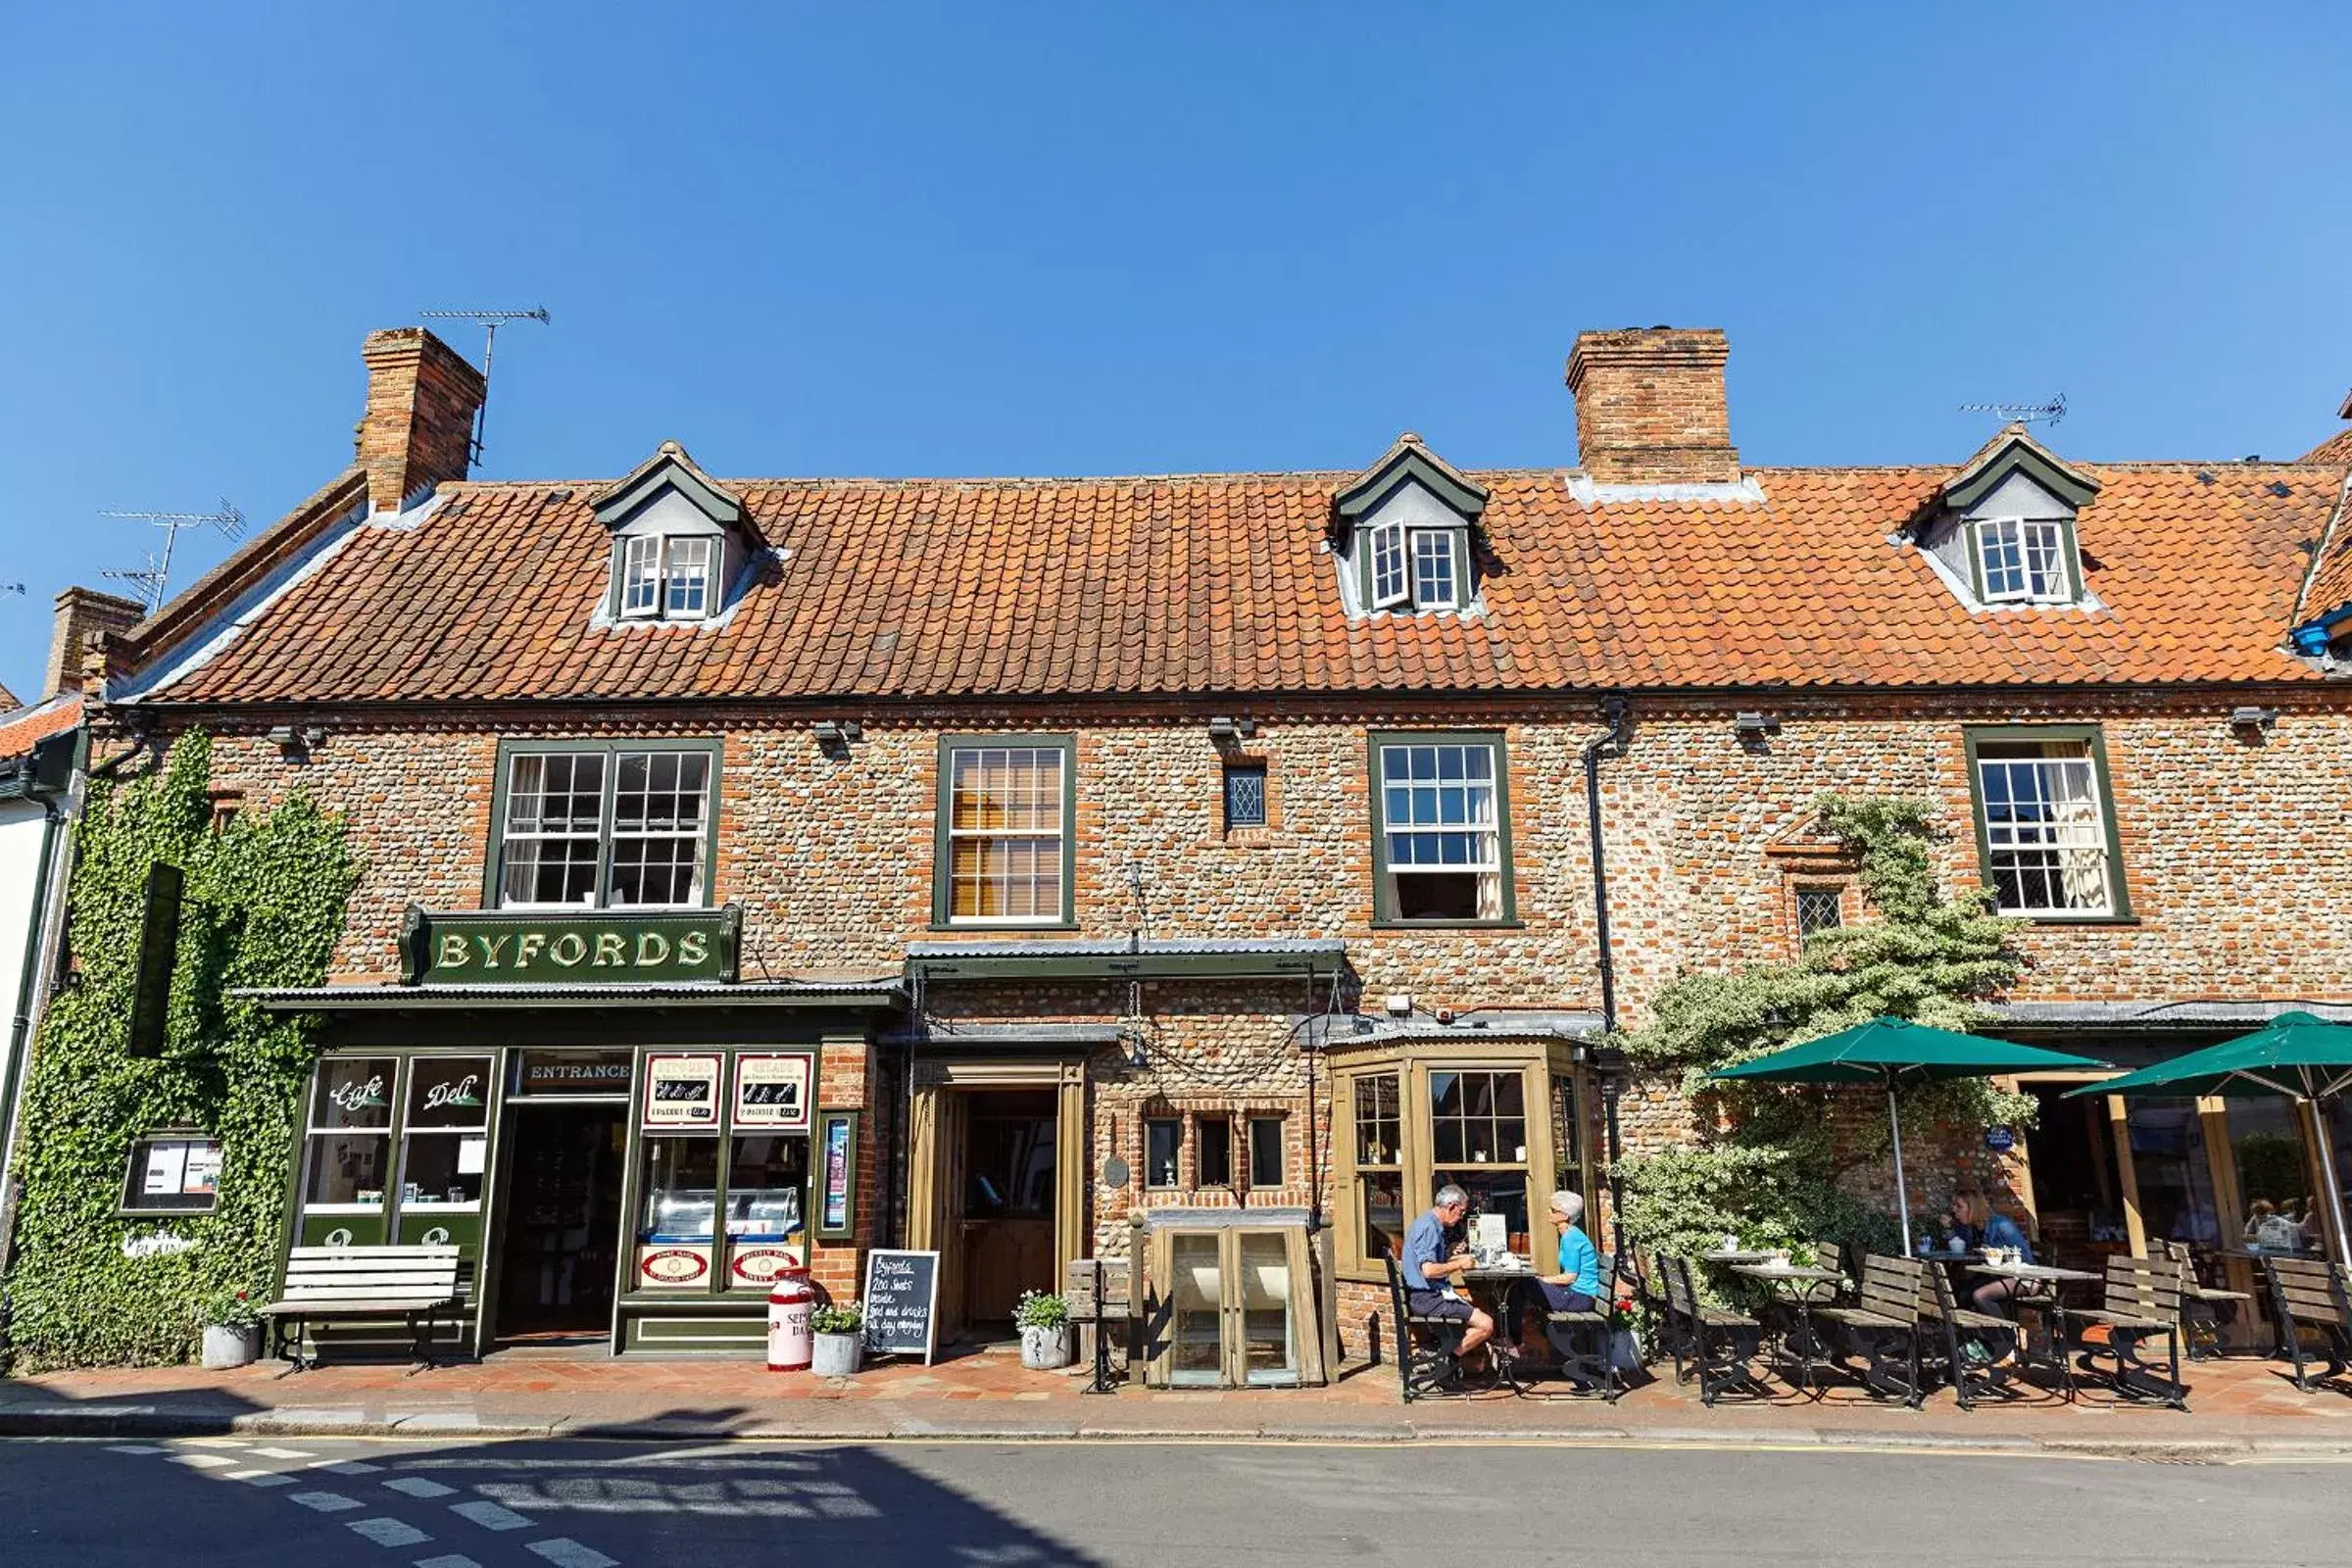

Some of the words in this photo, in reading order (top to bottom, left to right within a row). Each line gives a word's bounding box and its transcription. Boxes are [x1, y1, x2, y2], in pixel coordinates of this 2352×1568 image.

[435, 931, 710, 969] BYFORDS
[530, 1065, 630, 1079] ENTRANCE
[422, 1075, 477, 1110] Deli
[875, 1256, 911, 1277] Byfords
[871, 1277, 888, 1291] 200
[881, 1318, 896, 1337] day
